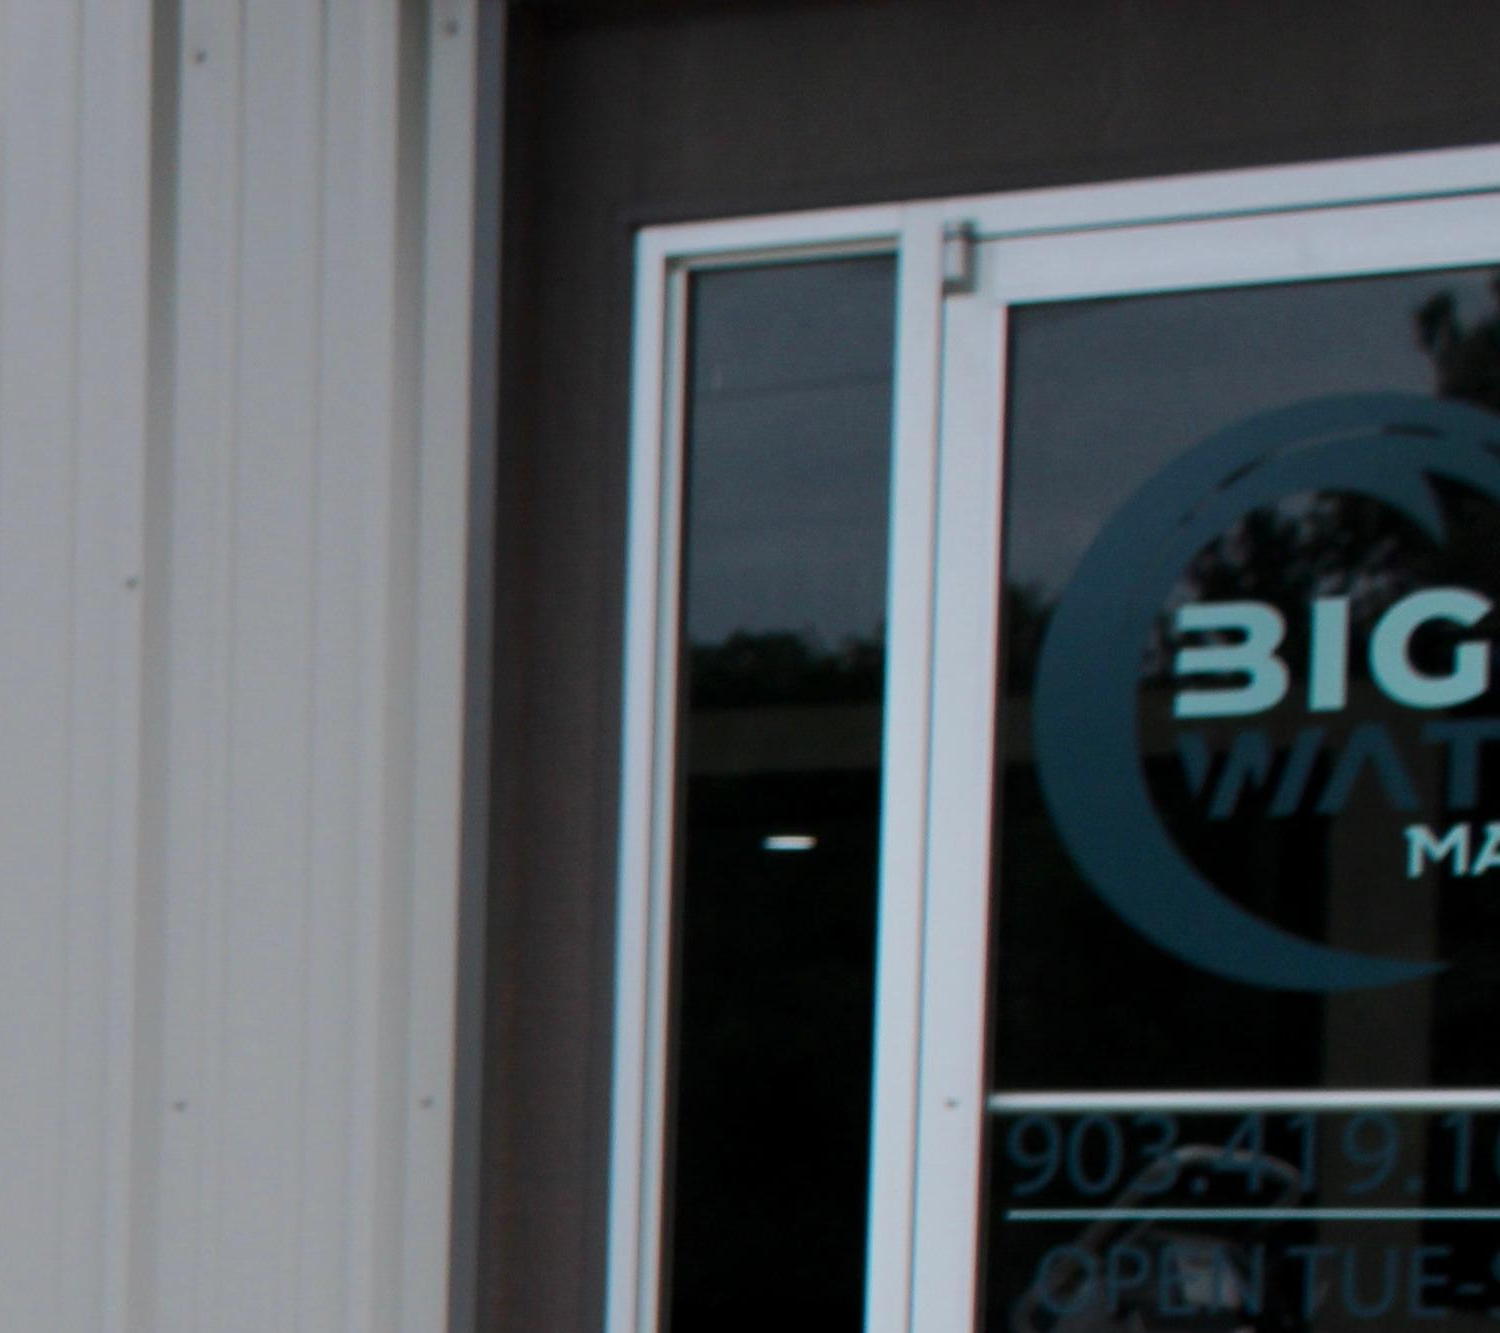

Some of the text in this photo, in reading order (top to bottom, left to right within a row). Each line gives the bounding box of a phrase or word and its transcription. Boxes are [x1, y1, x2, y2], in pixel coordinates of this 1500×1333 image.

[1172, 586, 1492, 718] BIG
[1005, 1113, 1500, 1200] 903.419.1
[1035, 1240, 1267, 1320] OPEN
